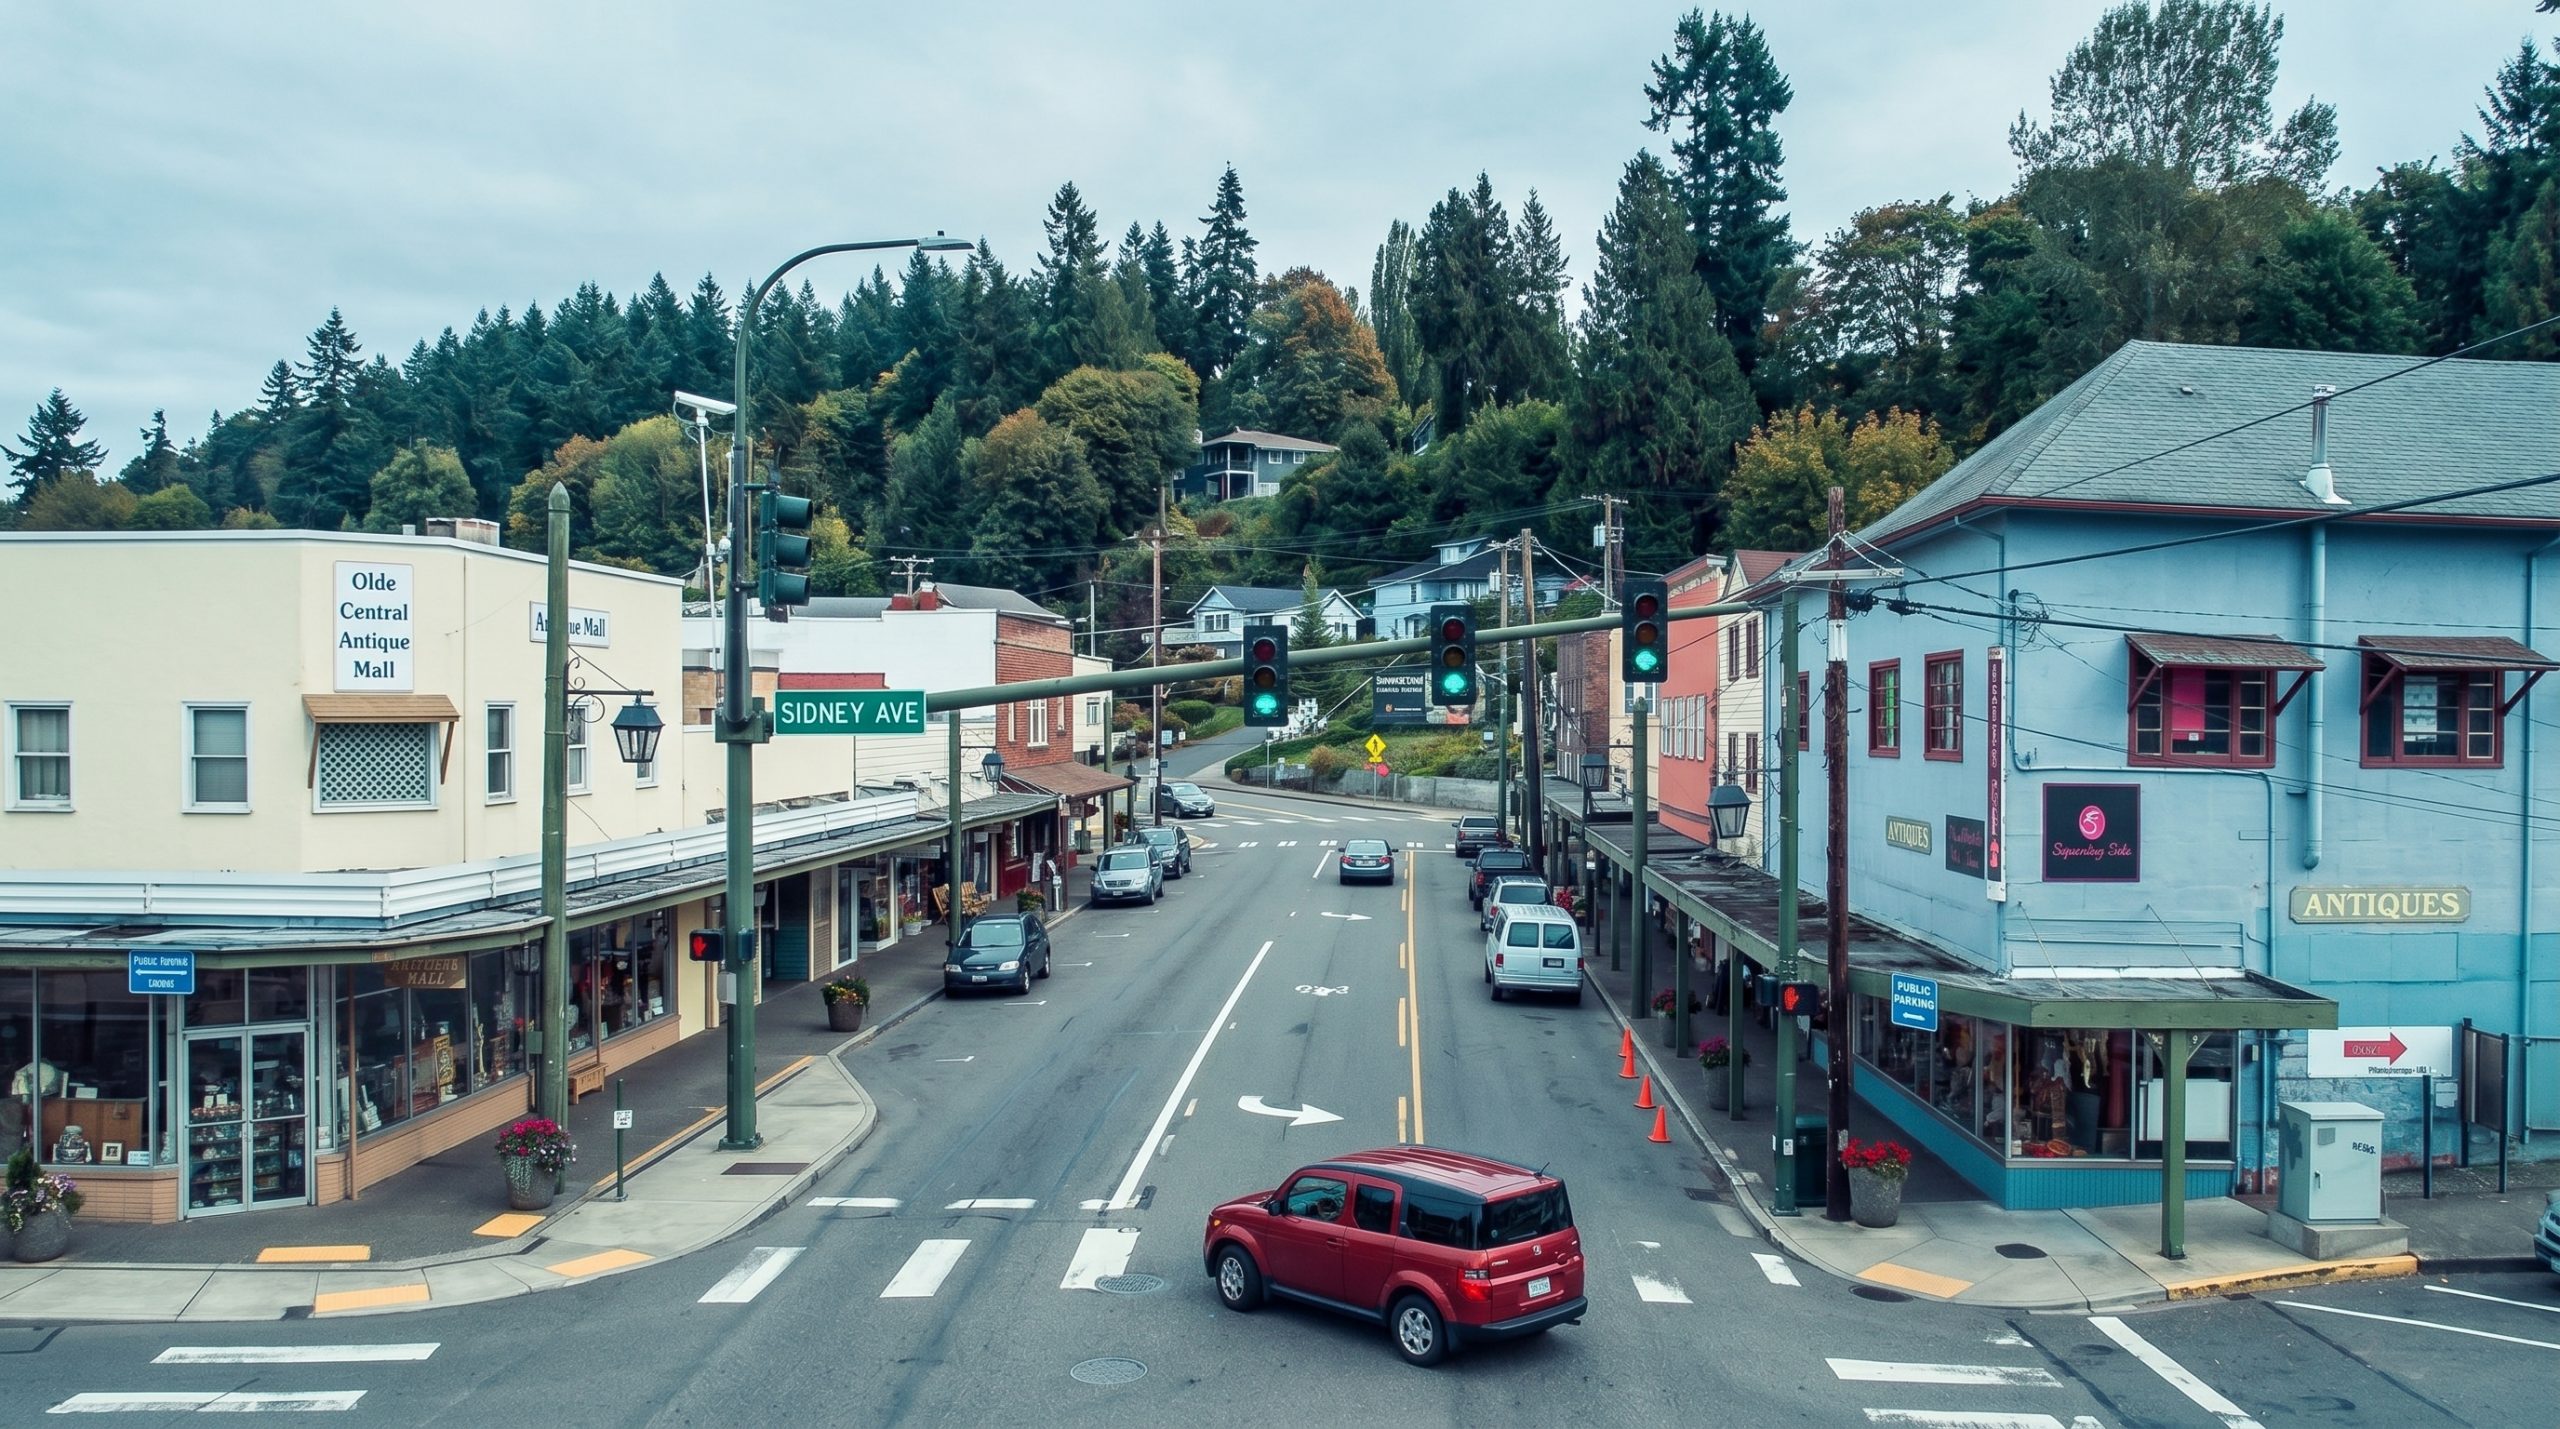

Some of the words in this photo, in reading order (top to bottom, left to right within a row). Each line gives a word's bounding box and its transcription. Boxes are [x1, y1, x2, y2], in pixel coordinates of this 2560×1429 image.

[352, 572, 397, 591] Olde
[340, 602, 408, 620] Central
[583, 617, 606, 637] Mall
[338, 631, 410, 653] Antique
[353, 660, 395, 678] Mall
[781, 702, 865, 724] SIDNEY
[875, 702, 919, 724] AVE
[2302, 892, 2460, 919] ANTIQUES
[1897, 981, 1931, 996] PUBLIC
[1894, 993, 1935, 1010] PARKING
